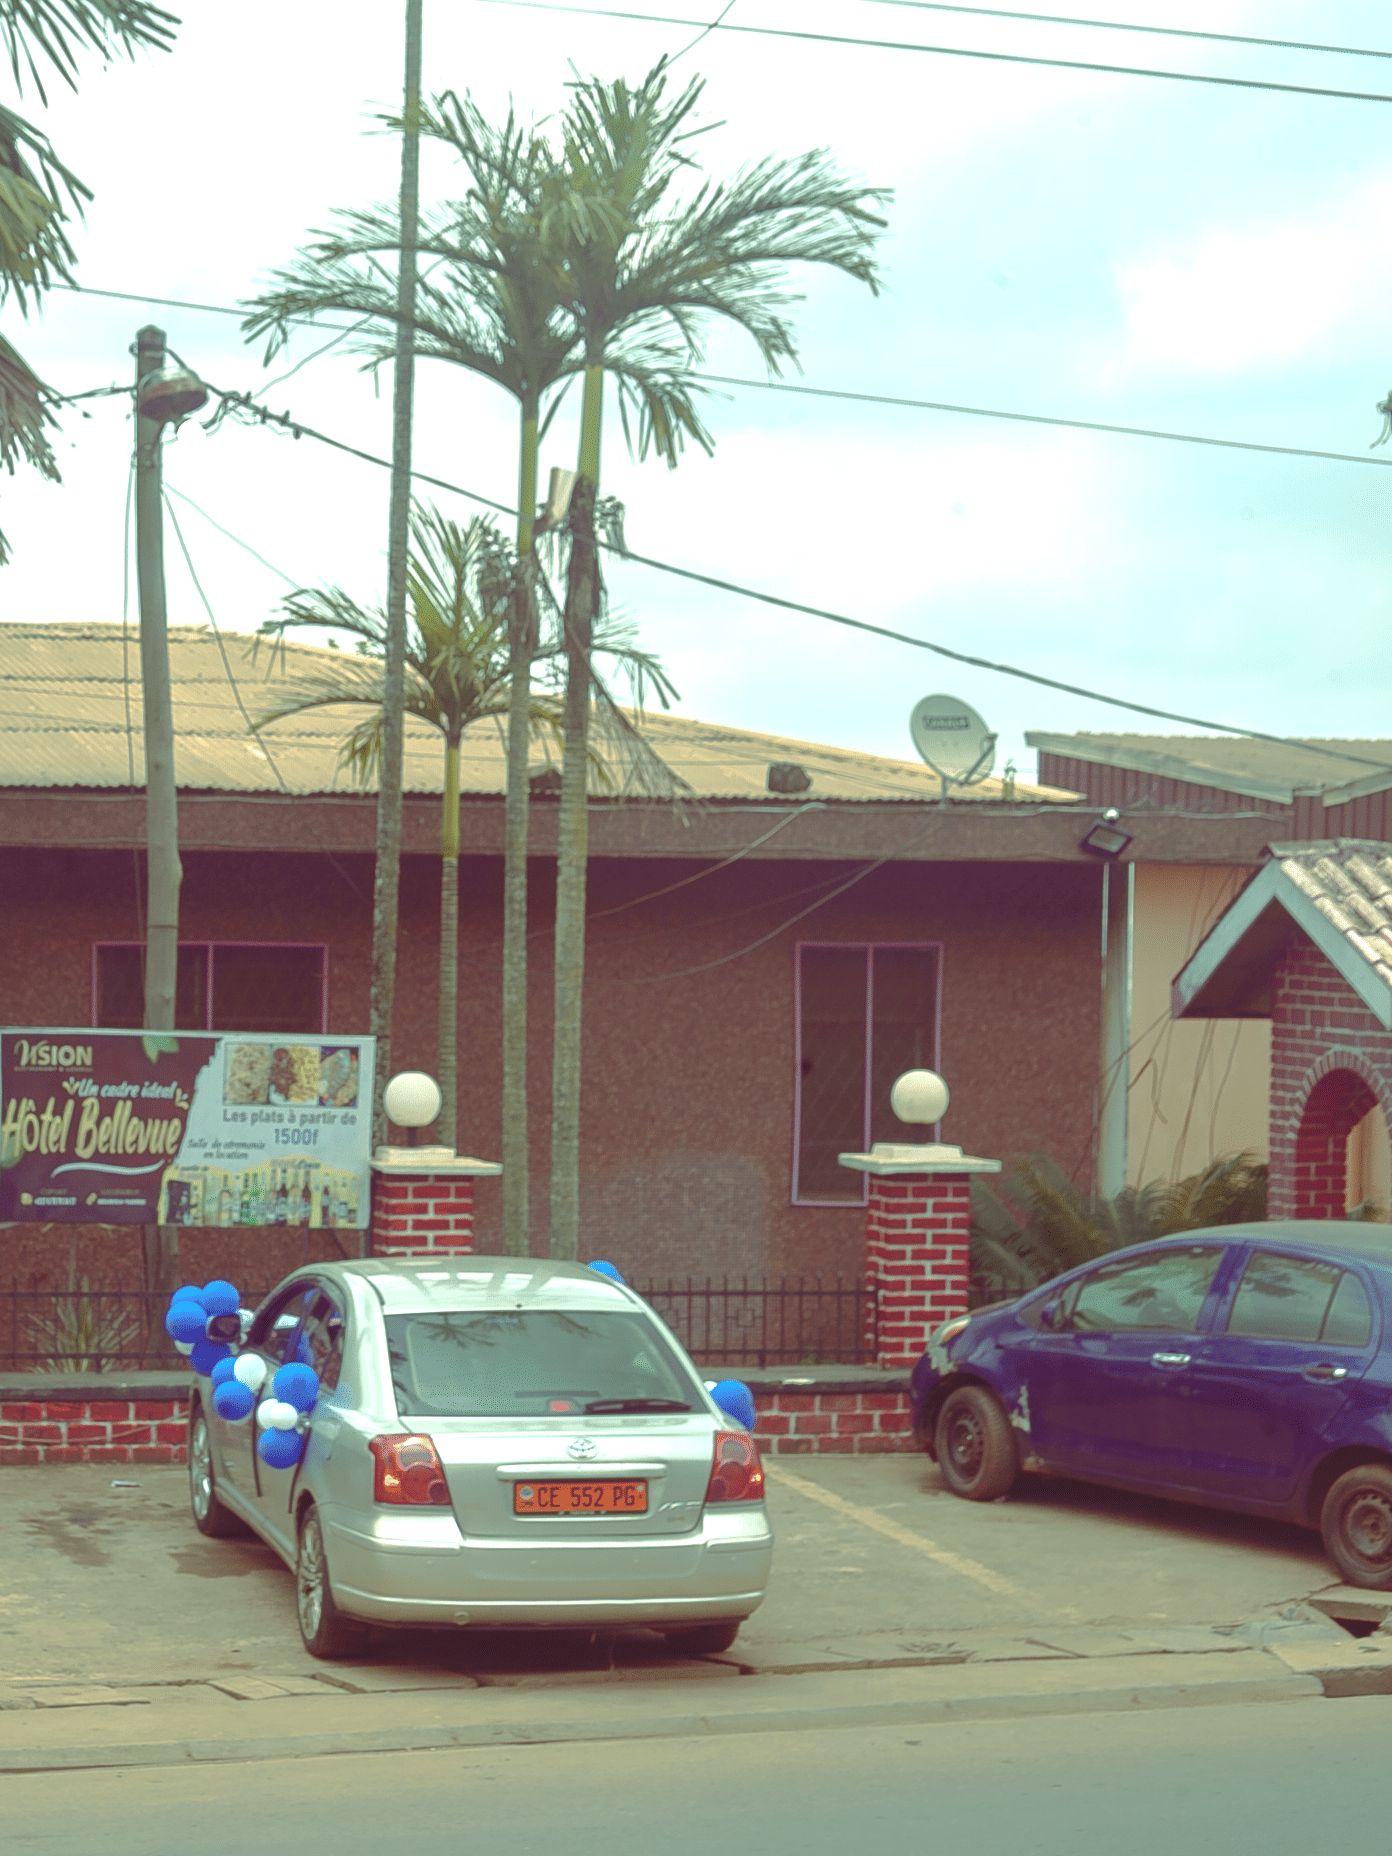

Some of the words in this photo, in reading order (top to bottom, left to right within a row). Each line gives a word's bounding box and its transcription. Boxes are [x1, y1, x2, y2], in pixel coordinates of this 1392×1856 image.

[78, 1078, 99, 1098] Un
[2, 1097, 75, 1157] Hôtel
[75, 1097, 182, 1159] Bellevue
[222, 1109, 248, 1123] Les
[250, 1110, 285, 1126] plats
[287, 1109, 297, 1123] à
[299, 1111, 337, 1127] partir
[340, 1111, 358, 1125] de
[274, 1128, 320, 1146] 1500f
[537, 1486, 561, 1508] CE
[570, 1485, 604, 1508] 552
[612, 1485, 636, 1507] PG
